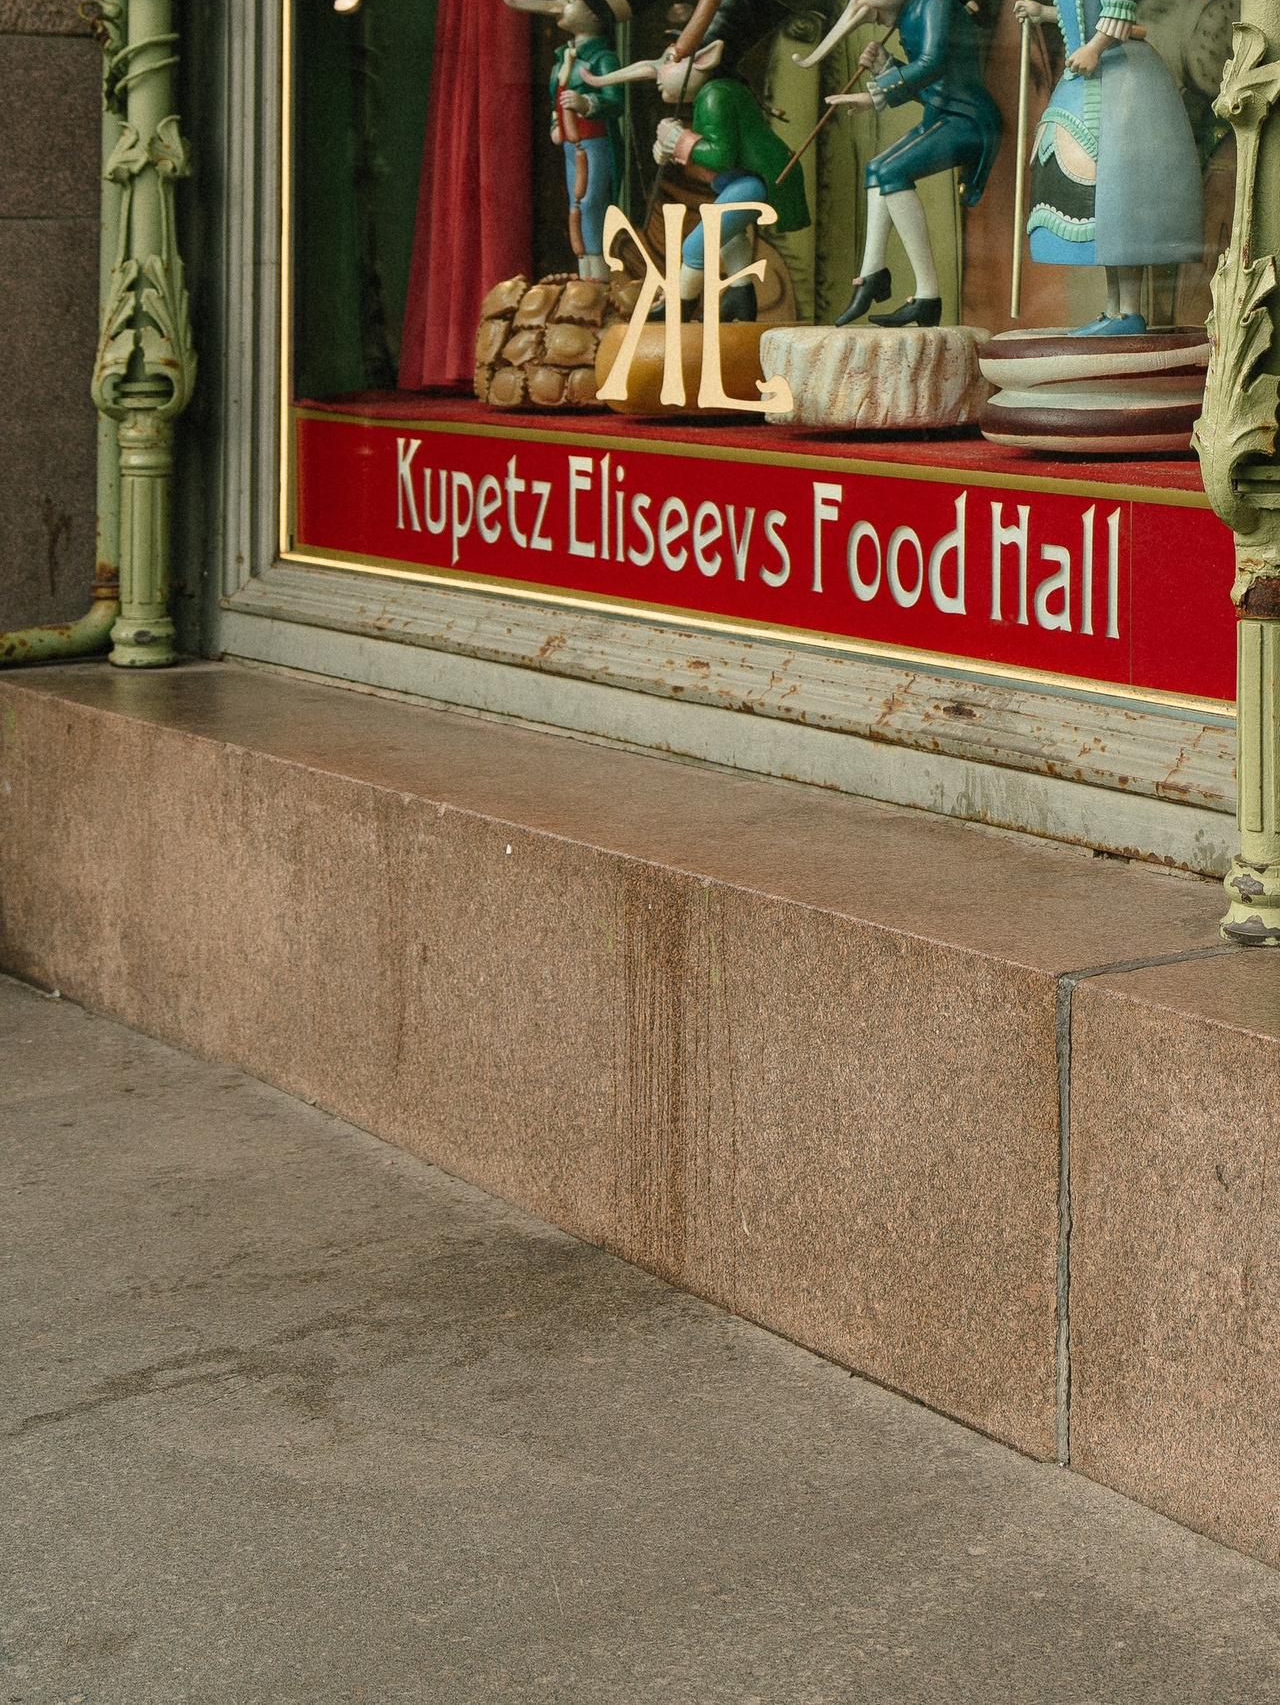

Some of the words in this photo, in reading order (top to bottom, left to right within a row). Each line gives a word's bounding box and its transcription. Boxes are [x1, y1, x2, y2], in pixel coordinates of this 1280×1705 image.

[395, 436, 554, 566] Kupetz
[566, 452, 792, 589] Eliseevs
[811, 481, 968, 617] Food
[989, 500, 1122, 641] Hall
